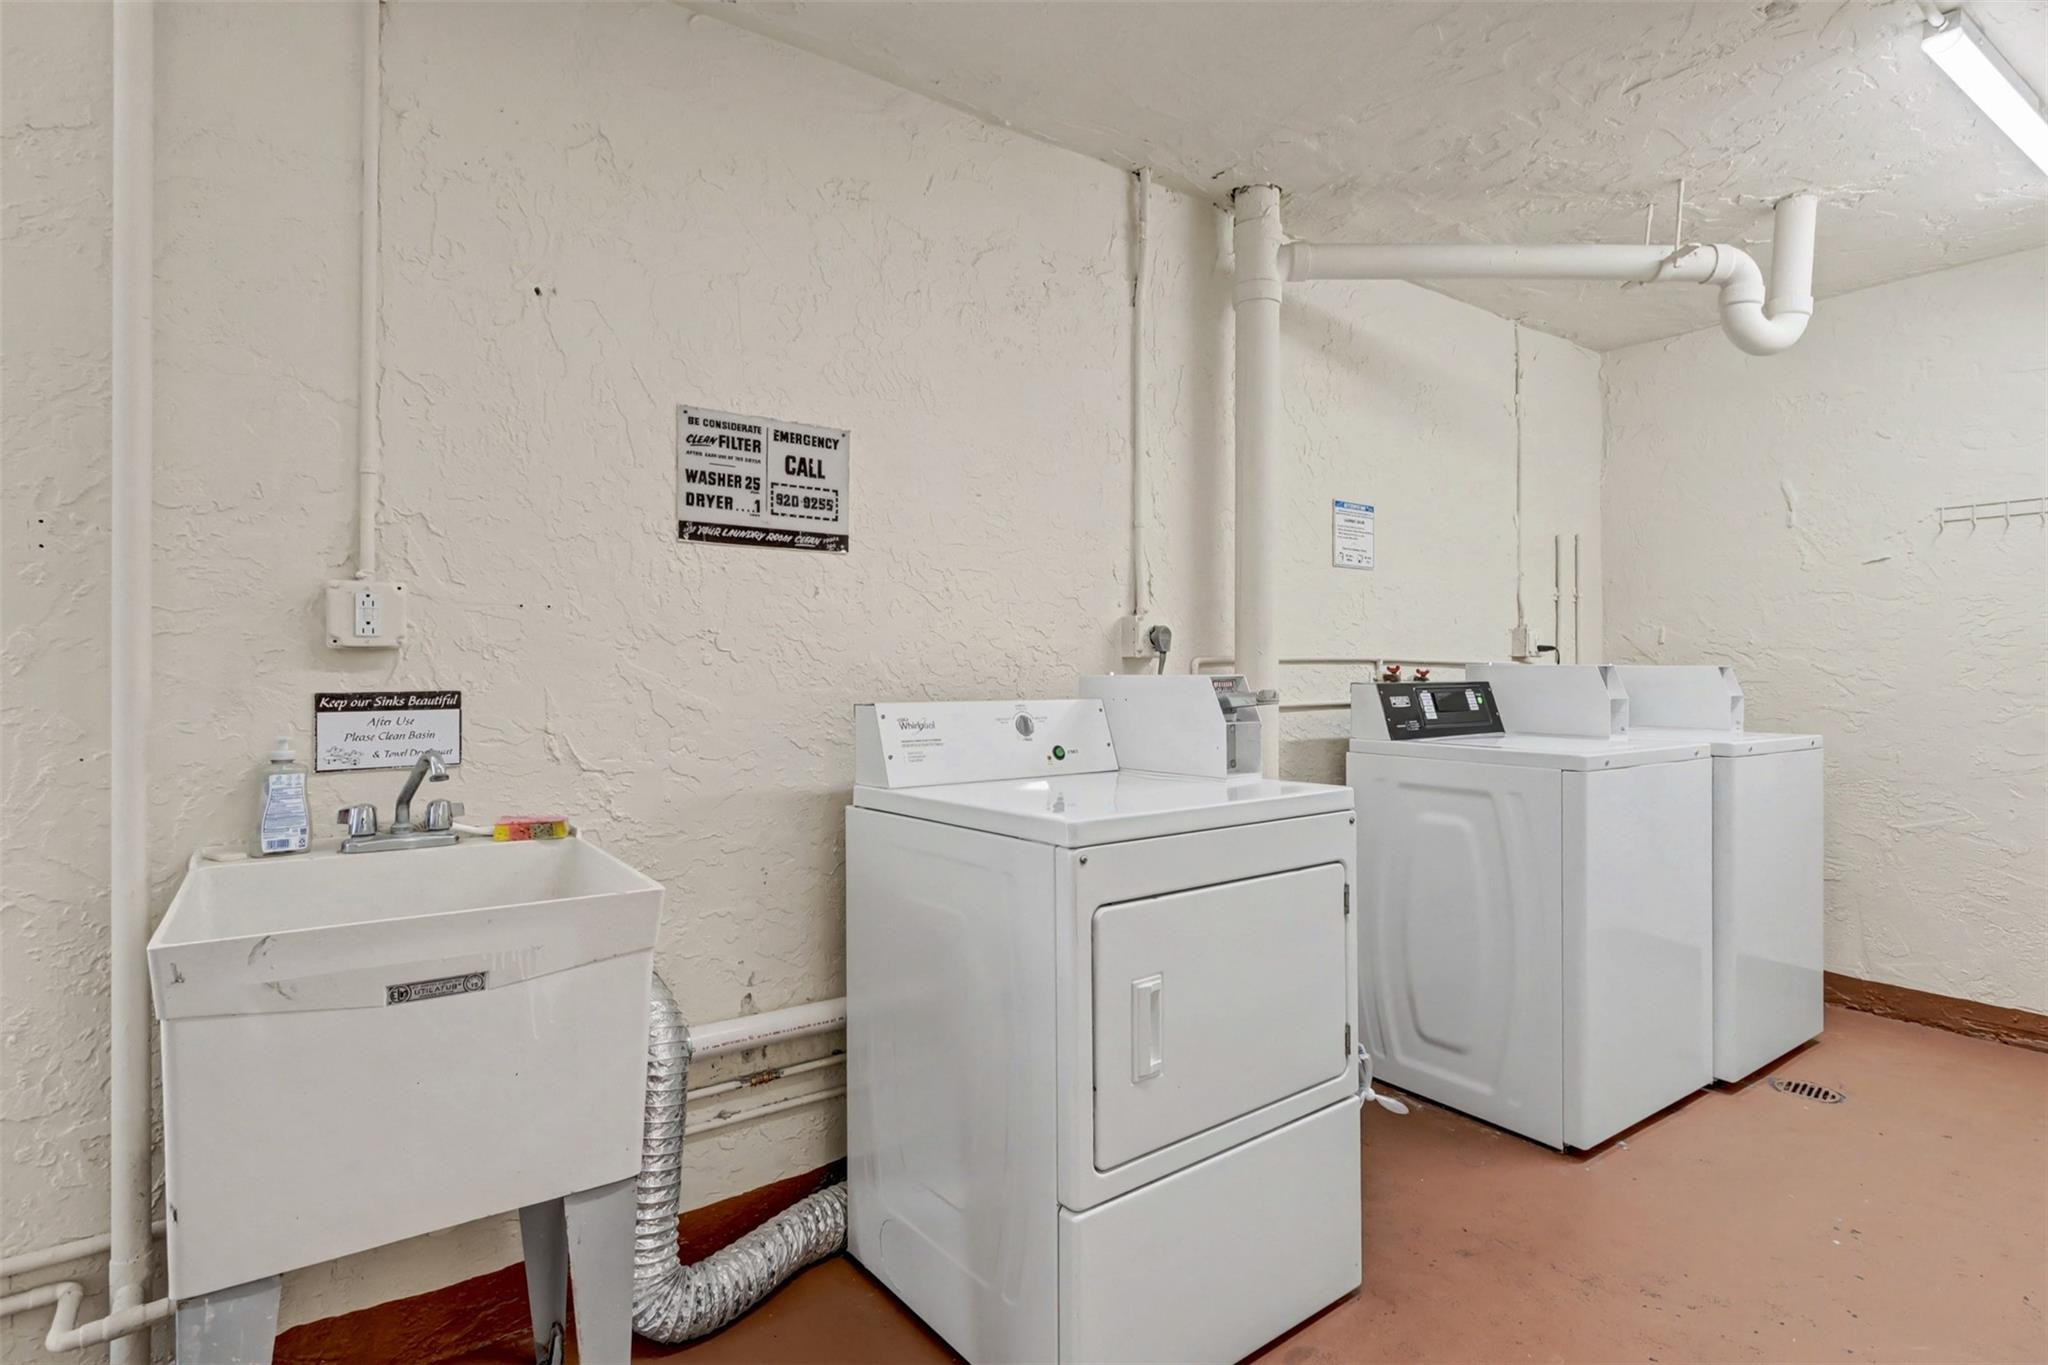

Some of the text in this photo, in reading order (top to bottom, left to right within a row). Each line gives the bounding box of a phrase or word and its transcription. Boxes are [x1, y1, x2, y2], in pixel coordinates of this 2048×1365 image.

[688, 416, 762, 435] BE CONSIDERATE
[686, 433, 762, 453] CLEAN FILTER
[773, 429, 839, 451] EMERGENCY
[784, 454, 826, 480] CALL
[685, 468, 761, 491] WASHER 25
[686, 492, 733, 511] DRYER
[775, 492, 799, 508] 920
[697, 525, 721, 537] YOUR
[721, 527, 766, 541] LAUNDRY
[765, 532, 793, 543] ROOM
[794, 535, 822, 546] CLEAN
[319, 693, 458, 711] Keep our Sinks Beautiful
[366, 715, 415, 728] After Use
[344, 730, 436, 742] Please Clean Basin
[371, 751, 381, 759] &
[384, 749, 408, 758] Towel
